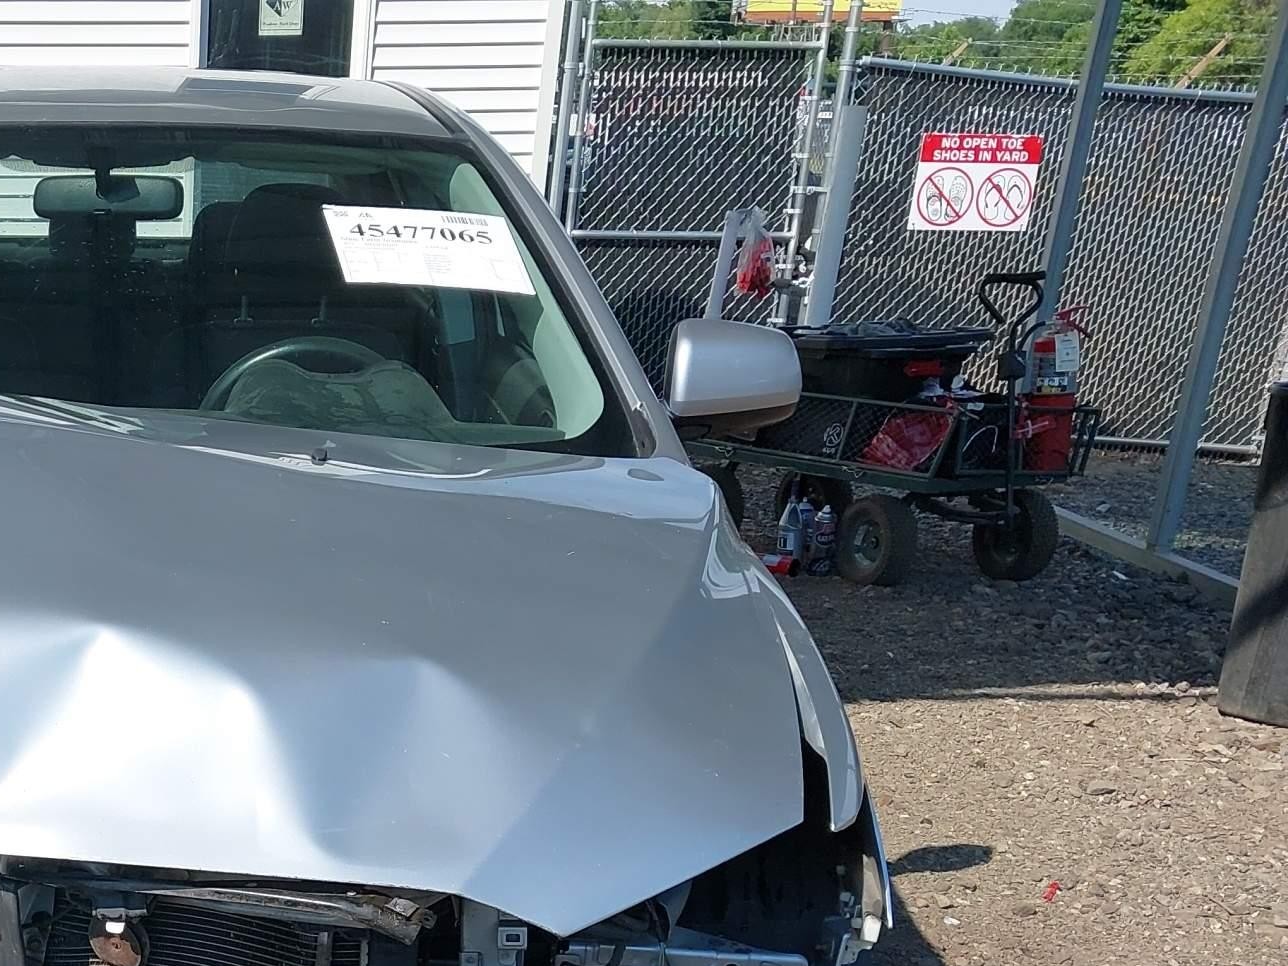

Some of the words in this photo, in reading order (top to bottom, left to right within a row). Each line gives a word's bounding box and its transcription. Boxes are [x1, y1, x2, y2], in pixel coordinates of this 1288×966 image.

[941, 137, 960, 148] NO
[963, 137, 997, 149] OPEN
[1001, 138, 1025, 149] TOE
[933, 150, 975, 161] SHOES
[978, 150, 992, 161] IN
[996, 150, 1029, 162] YARD
[349, 223, 493, 245] 45477065
